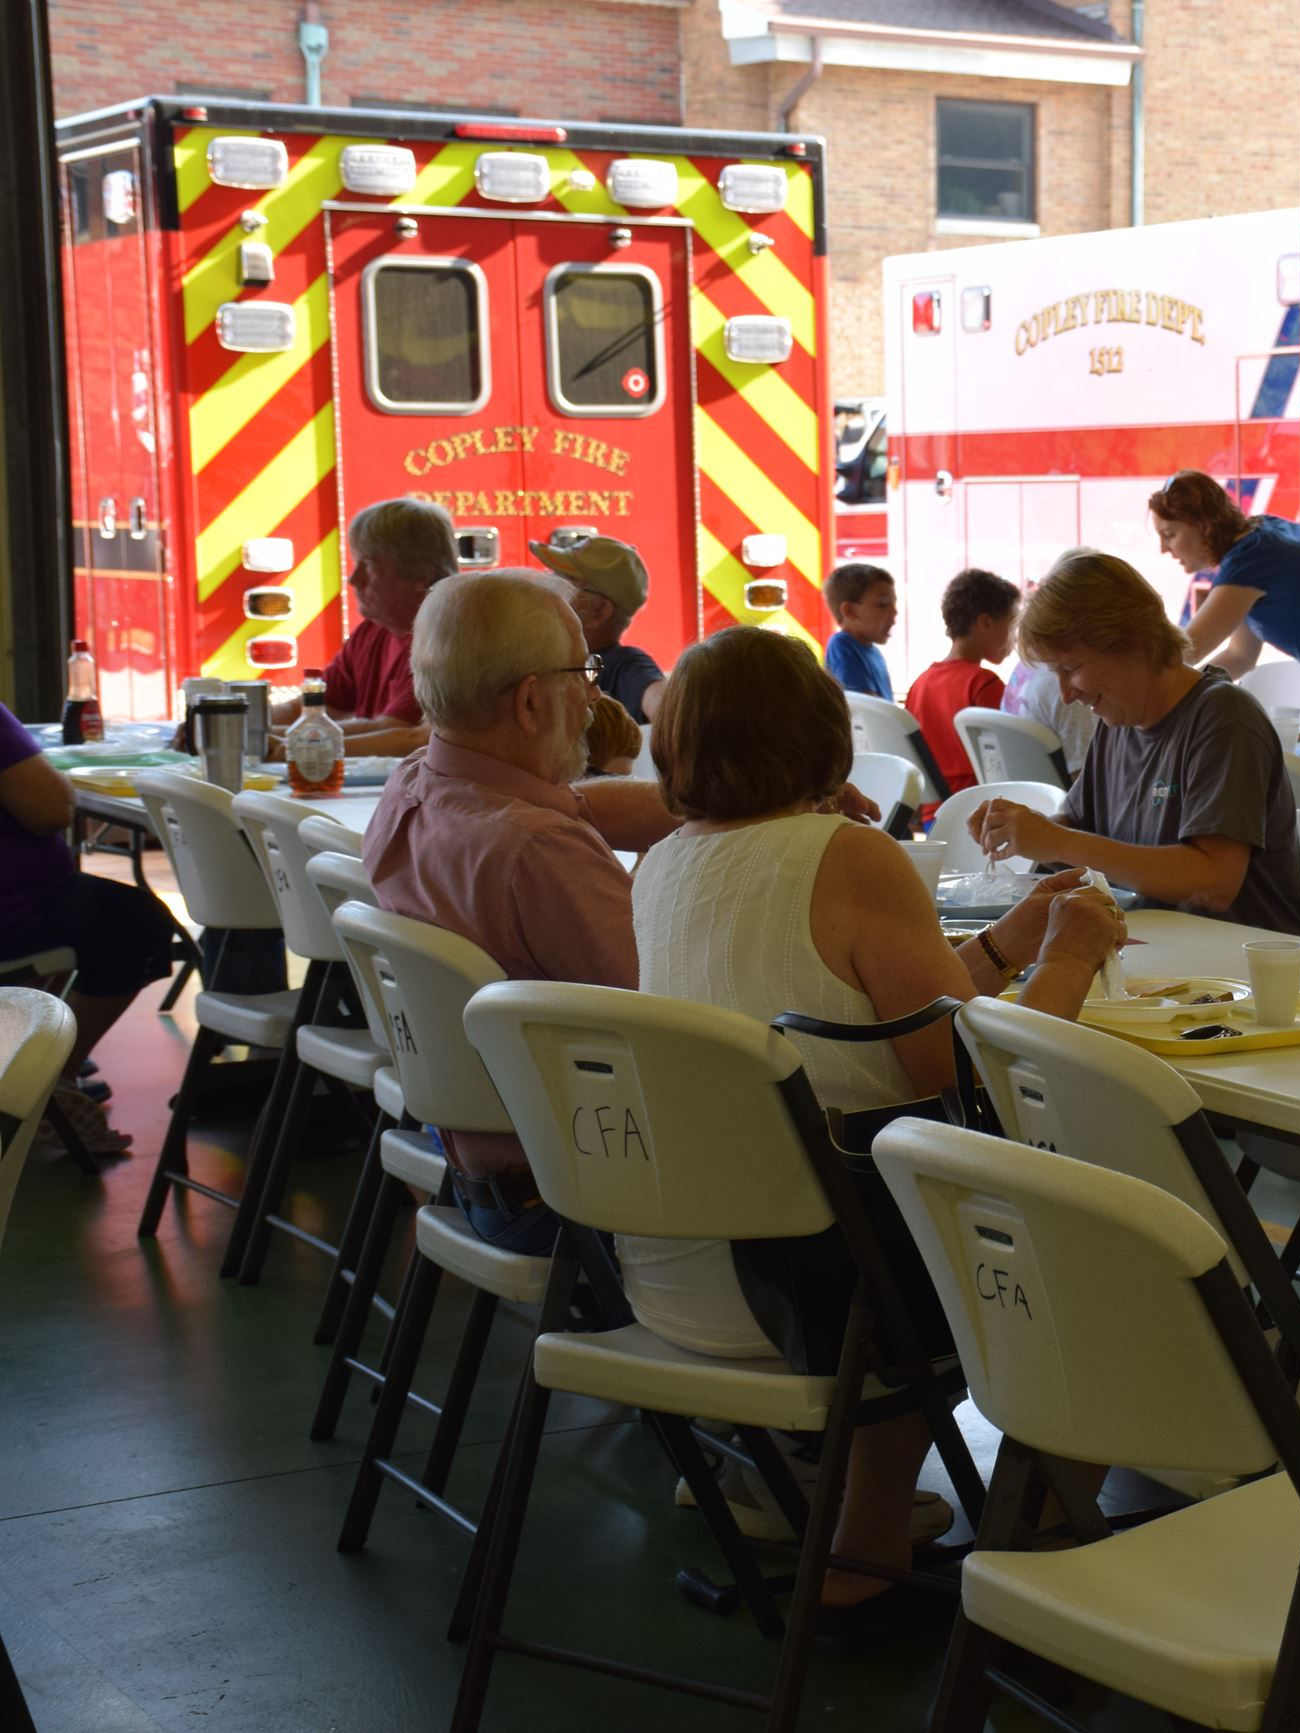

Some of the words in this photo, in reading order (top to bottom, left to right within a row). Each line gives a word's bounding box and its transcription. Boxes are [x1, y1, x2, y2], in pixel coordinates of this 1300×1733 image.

[1014, 291, 1092, 356] COPLEY
[1093, 289, 1142, 324] FIRE
[403, 426, 540, 477] COPLEY
[551, 429, 631, 477] FIRE
[572, 1106, 650, 1162] CFA
[976, 1263, 1033, 1321] CFA
